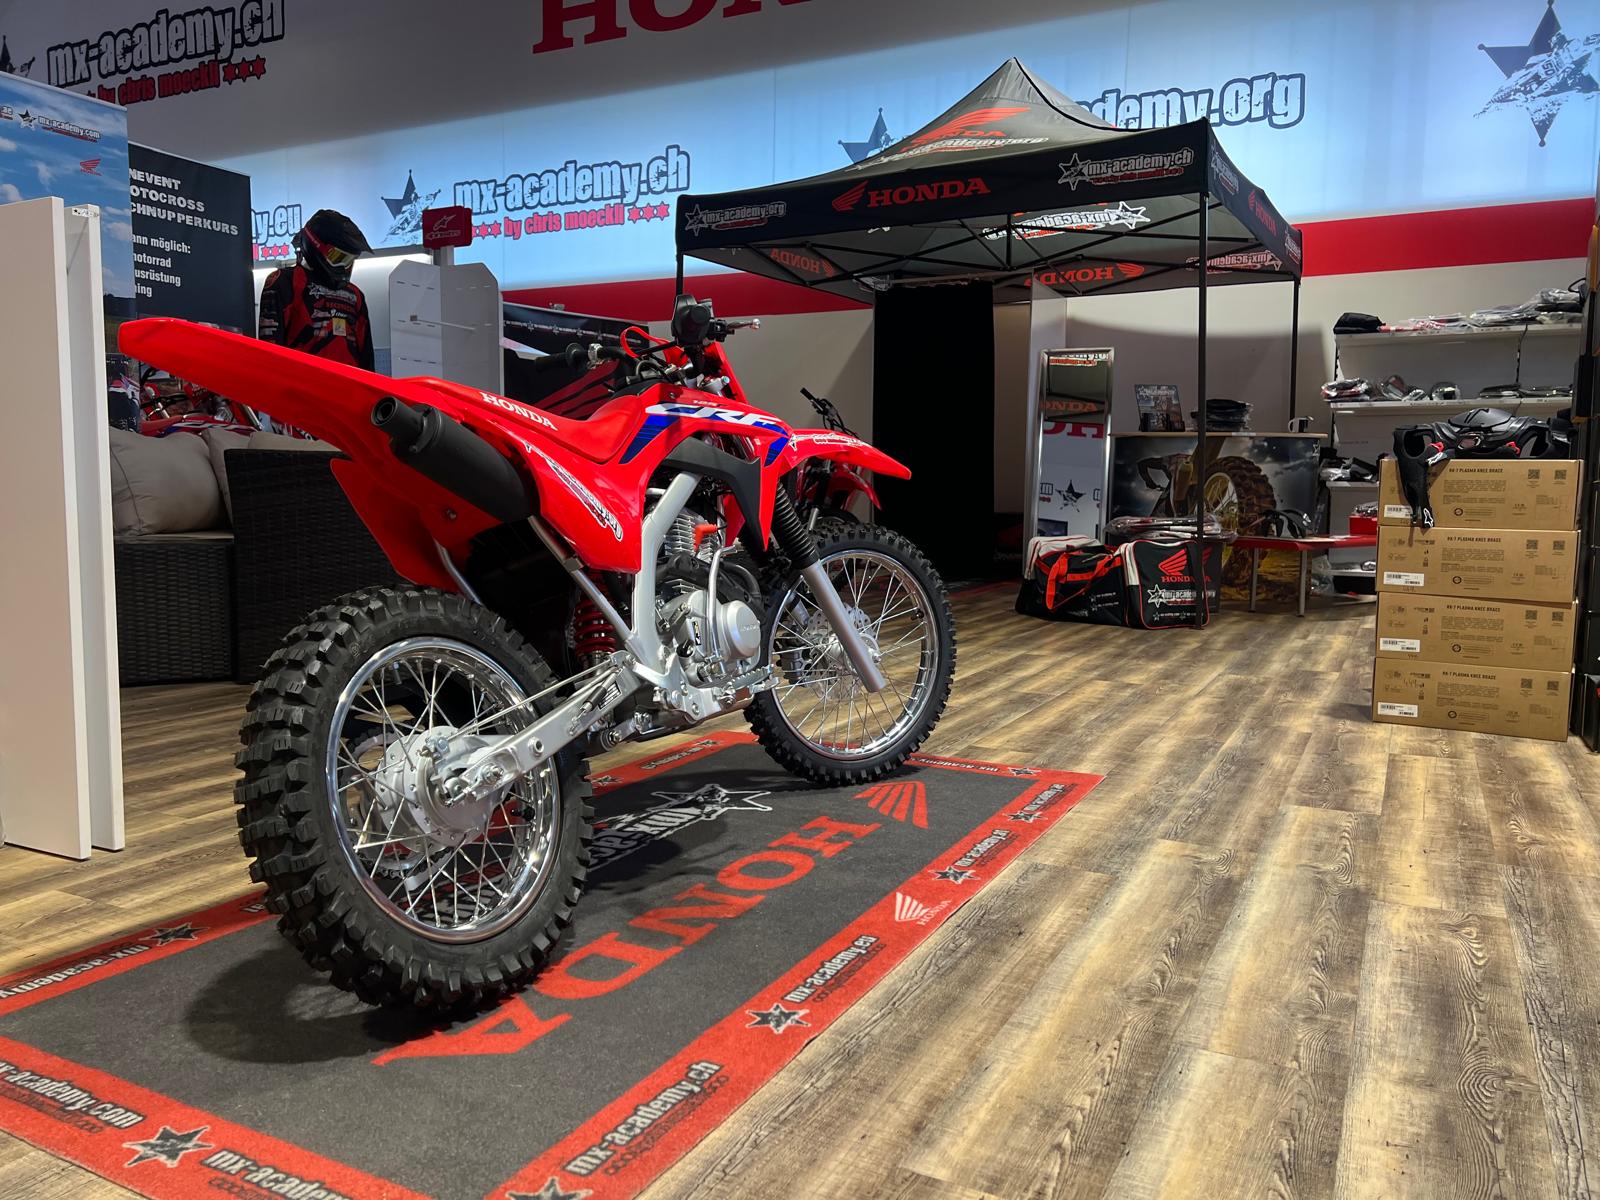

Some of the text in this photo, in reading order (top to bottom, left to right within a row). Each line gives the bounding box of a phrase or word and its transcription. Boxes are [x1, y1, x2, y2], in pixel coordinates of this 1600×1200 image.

[453, 144, 691, 216] mx-academy.ch
[1087, 149, 1192, 176] mx-academy.ch
[867, 177, 991, 207] HONDA
[503, 216, 522, 241] by
[524, 211, 562, 237] chris
[150, 238, 191, 254] möglich:
[479, 391, 559, 431] HONDA
[783, 934, 878, 1003] mx-academy.eu
[564, 1060, 723, 1176] mx-academy.ch
